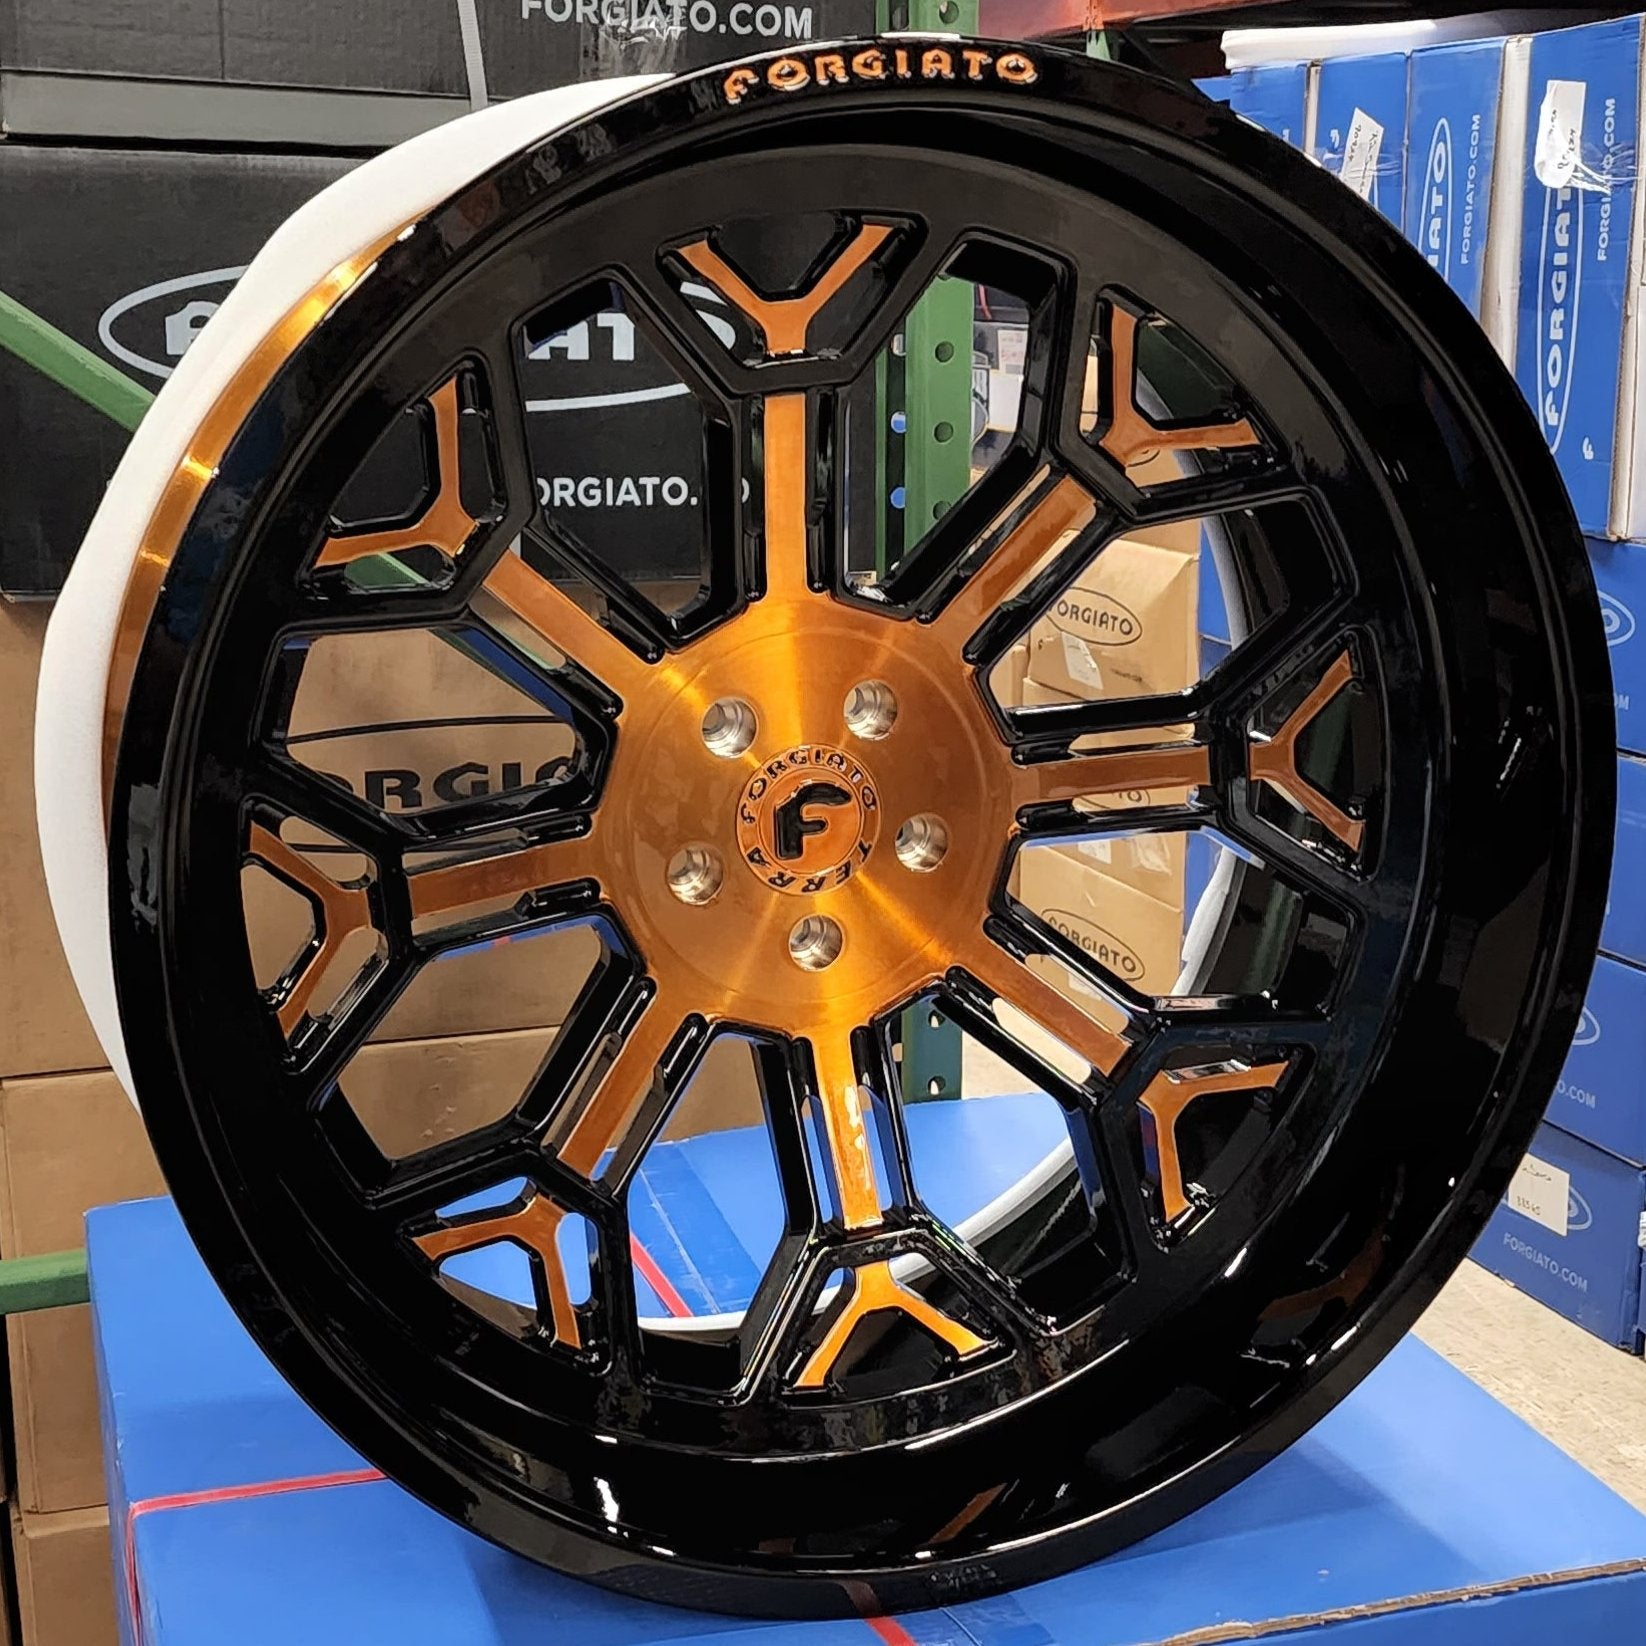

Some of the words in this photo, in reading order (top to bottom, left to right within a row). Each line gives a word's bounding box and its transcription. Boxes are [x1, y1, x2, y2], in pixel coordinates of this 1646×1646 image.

[723, 49, 1038, 104] FORGIATO
[1460, 114, 1481, 264] FORGIATO.COM
[1597, 98, 1615, 261] FORGIO.COM
[1049, 599, 1133, 636] ORGIATO
[741, 749, 877, 824] FORGIATO
[775, 782, 852, 859] F
[746, 838, 873, 893] TERRA
[1502, 1232, 1588, 1292] FORGIATO.COM
